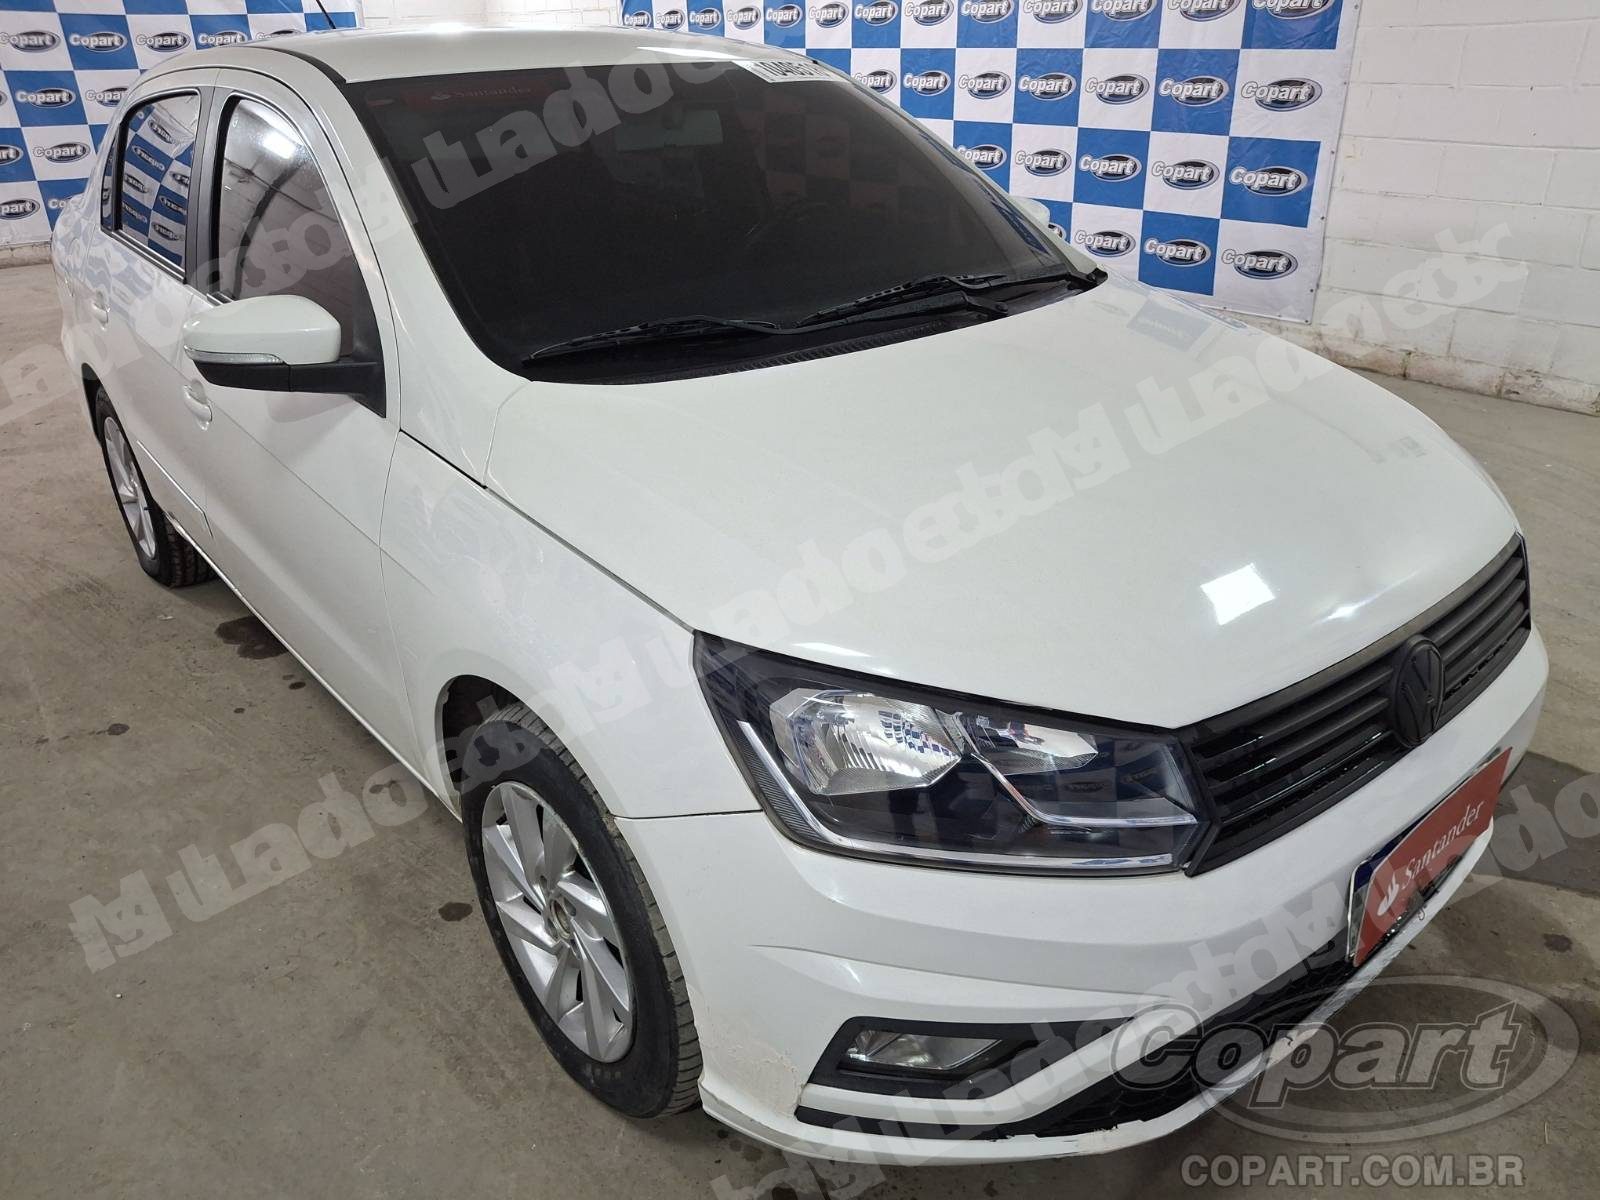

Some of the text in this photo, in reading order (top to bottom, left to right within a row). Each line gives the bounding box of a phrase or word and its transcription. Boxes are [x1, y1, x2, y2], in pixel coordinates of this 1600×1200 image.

[766, 8, 798, 23] Copart
[809, 6, 844, 23] Copart
[854, 4, 893, 21] Copart
[905, 2, 947, 21] Copart
[961, 0, 1007, 18] Copart
[1023, 0, 1074, 17] Copart
[1092, 0, 1146, 15] Copart
[625, 14, 648, 27] Copart
[656, 13, 681, 26] Copart
[689, 11, 718, 25] Copart
[727, 9, 757, 24] Copart
[70, 34, 121, 49] Copart
[136, 34, 184, 48] Copart
[199, 33, 243, 47] Copart
[904, 74, 945, 90] Copart
[959, 75, 1004, 92] Copart
[1018, 77, 1069, 95] Copart
[1085, 78, 1141, 97] Copart
[1159, 79, 1221, 99] Copart
[17, 91, 69, 105] Copart
[1241, 82, 1309, 103] Copart
[33, 146, 83, 160] Copart
[1015, 151, 1066, 171] Copart
[1080, 154, 1135, 174] Copart
[1152, 161, 1213, 182] Copart
[1229, 167, 1298, 189] Copart
[1075, 230, 1128, 251] Copart
[1145, 239, 1203, 261] Copart
[1222, 249, 1288, 272] Copart
[1402, 801, 1485, 889] Santander
